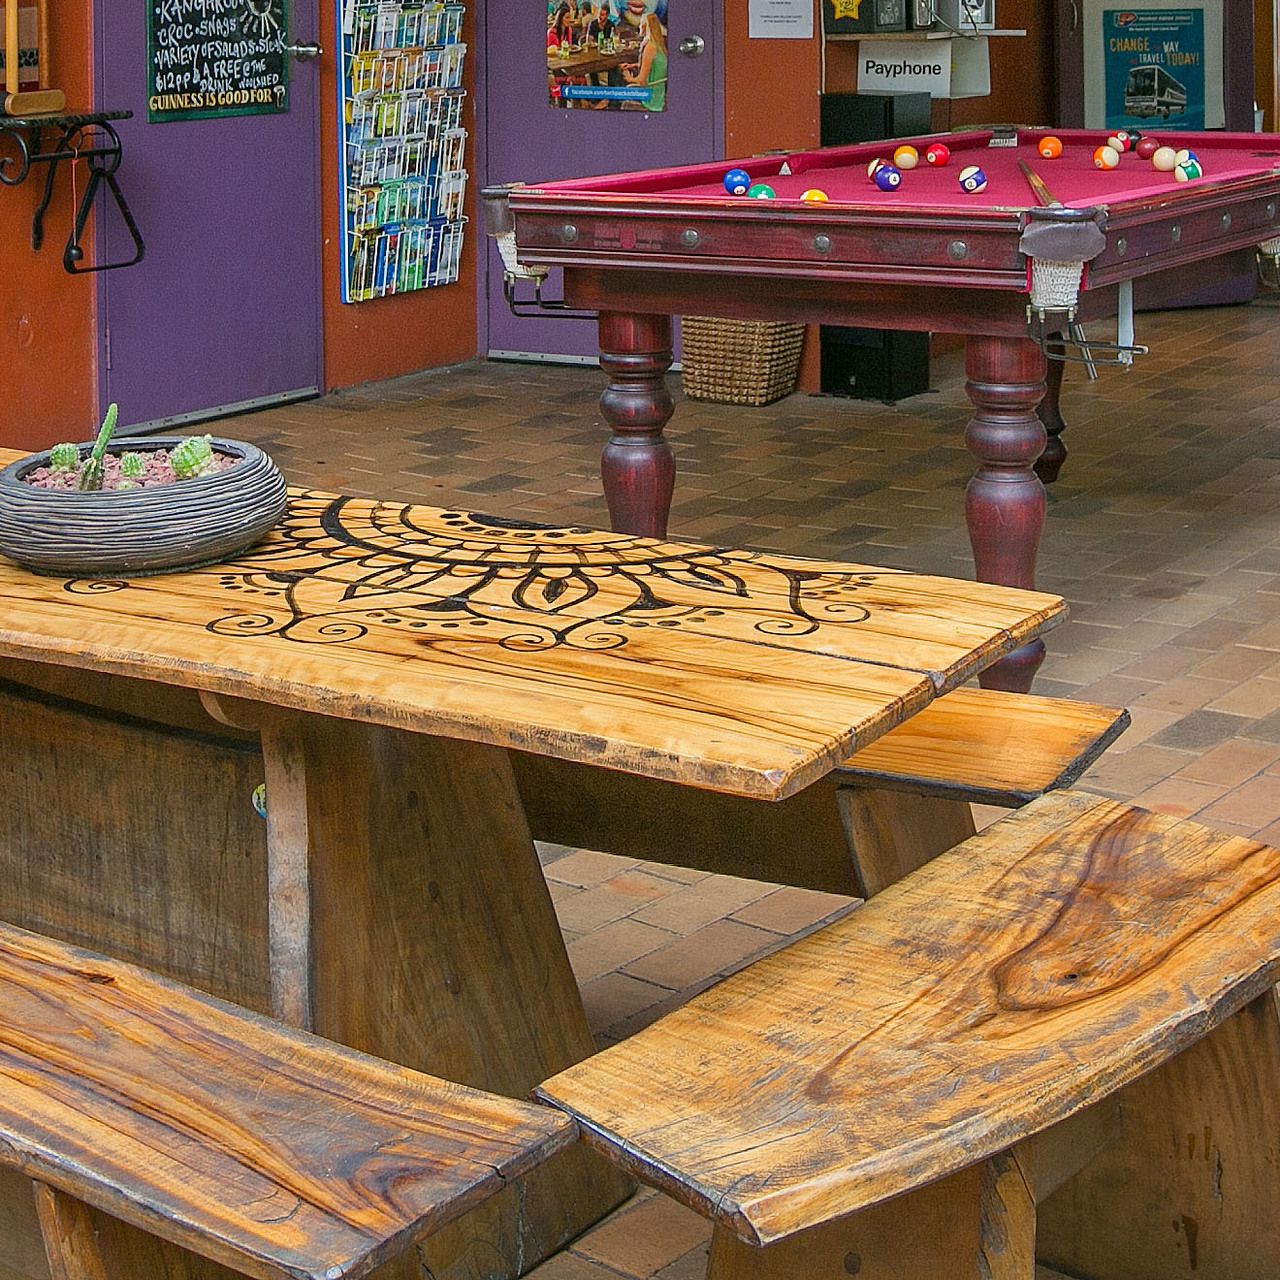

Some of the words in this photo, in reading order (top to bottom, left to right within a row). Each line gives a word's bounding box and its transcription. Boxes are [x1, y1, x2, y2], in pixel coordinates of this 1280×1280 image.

[1109, 37, 1149, 53] CHANGE
[1163, 41, 1179, 54] WAY
[157, 44, 200, 70] VARIETY
[1139, 53, 1165, 64] TRAVEL
[1166, 53, 1200, 67] TODAY!
[214, 59, 242, 79] FREE
[865, 60, 942, 78] Payphone
[200, 77, 233, 93] DRINK
[149, 92, 203, 111] GUINNESS
[206, 92, 216, 106] IS
[218, 90, 249, 106] GOOD
[250, 88, 273, 103] FOR
